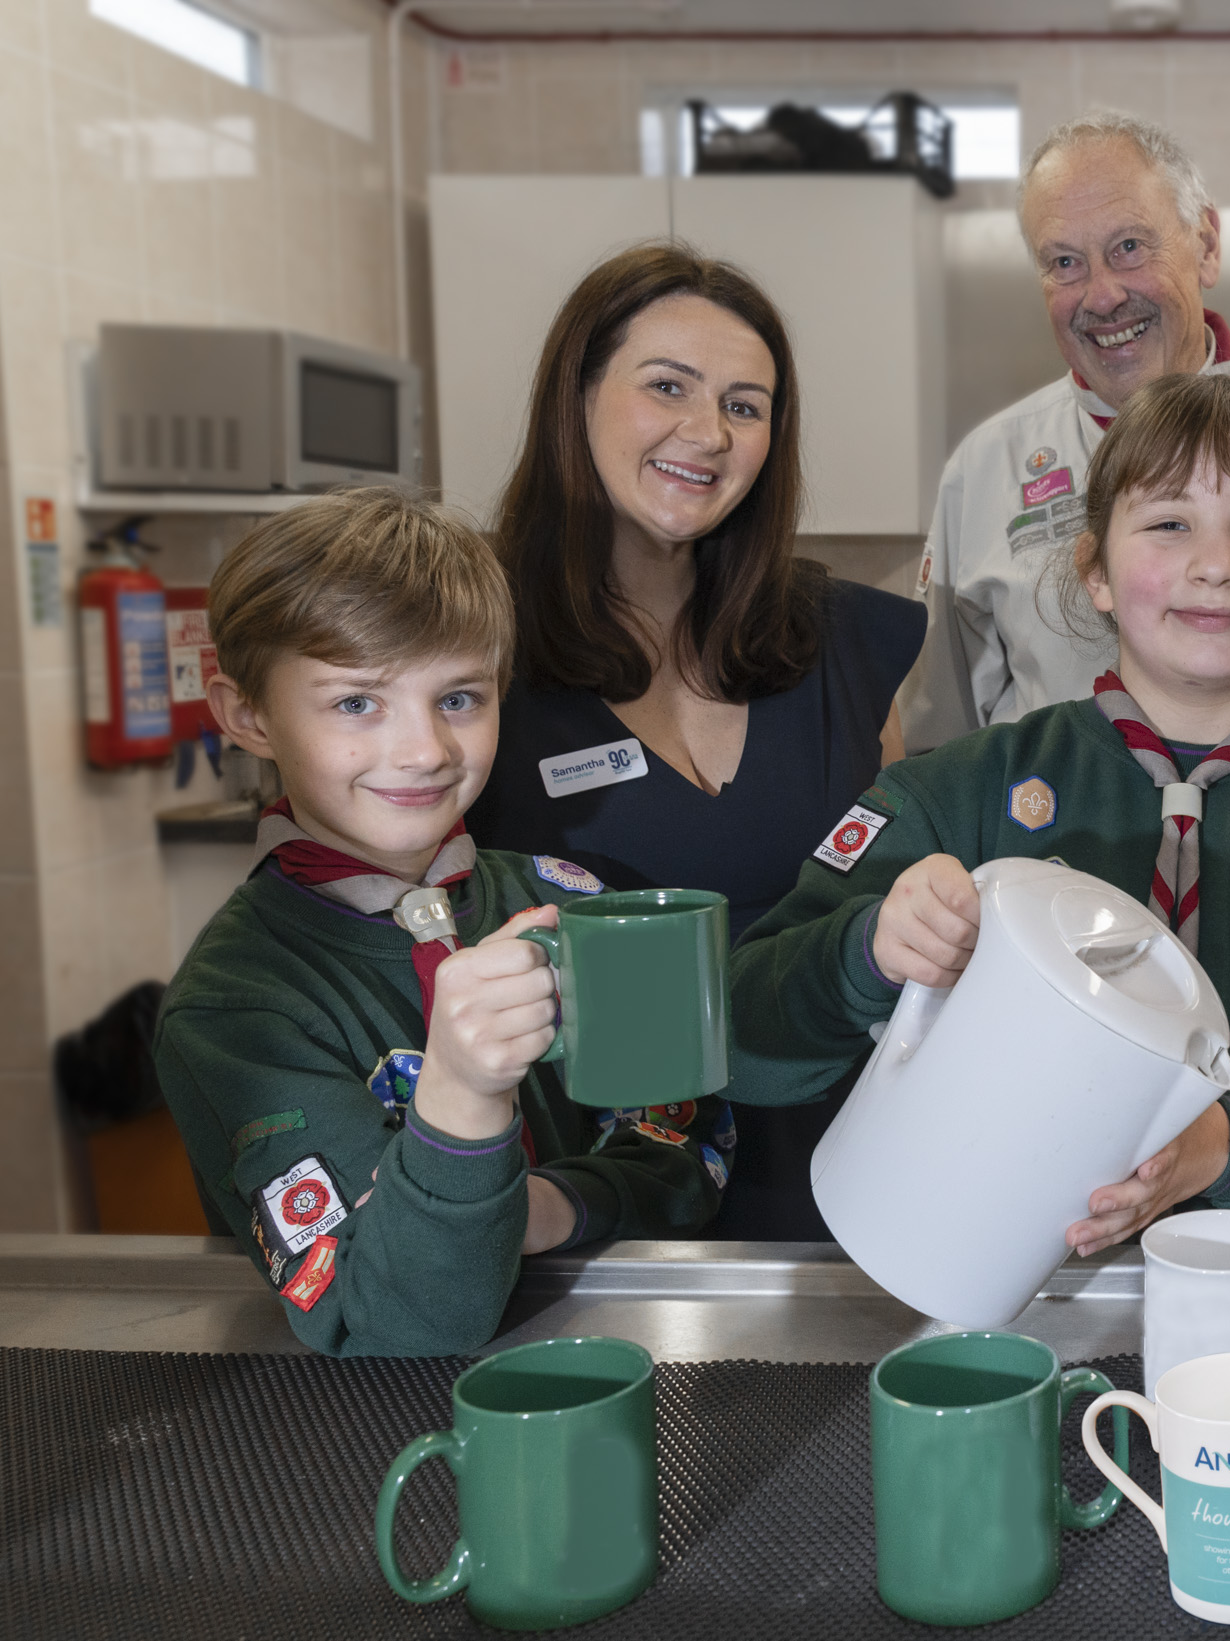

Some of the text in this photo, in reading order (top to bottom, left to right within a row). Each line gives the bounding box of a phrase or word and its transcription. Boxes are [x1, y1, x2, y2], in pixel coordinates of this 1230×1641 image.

[551, 759, 605, 778] Samantha
[859, 812, 876, 823] WEST
[820, 848, 850, 866] LANCASHIRE
[281, 1167, 303, 1186] WEST
[296, 1212, 343, 1246] LANCASHIRE
[1216, 1556, 1228, 1564] for
